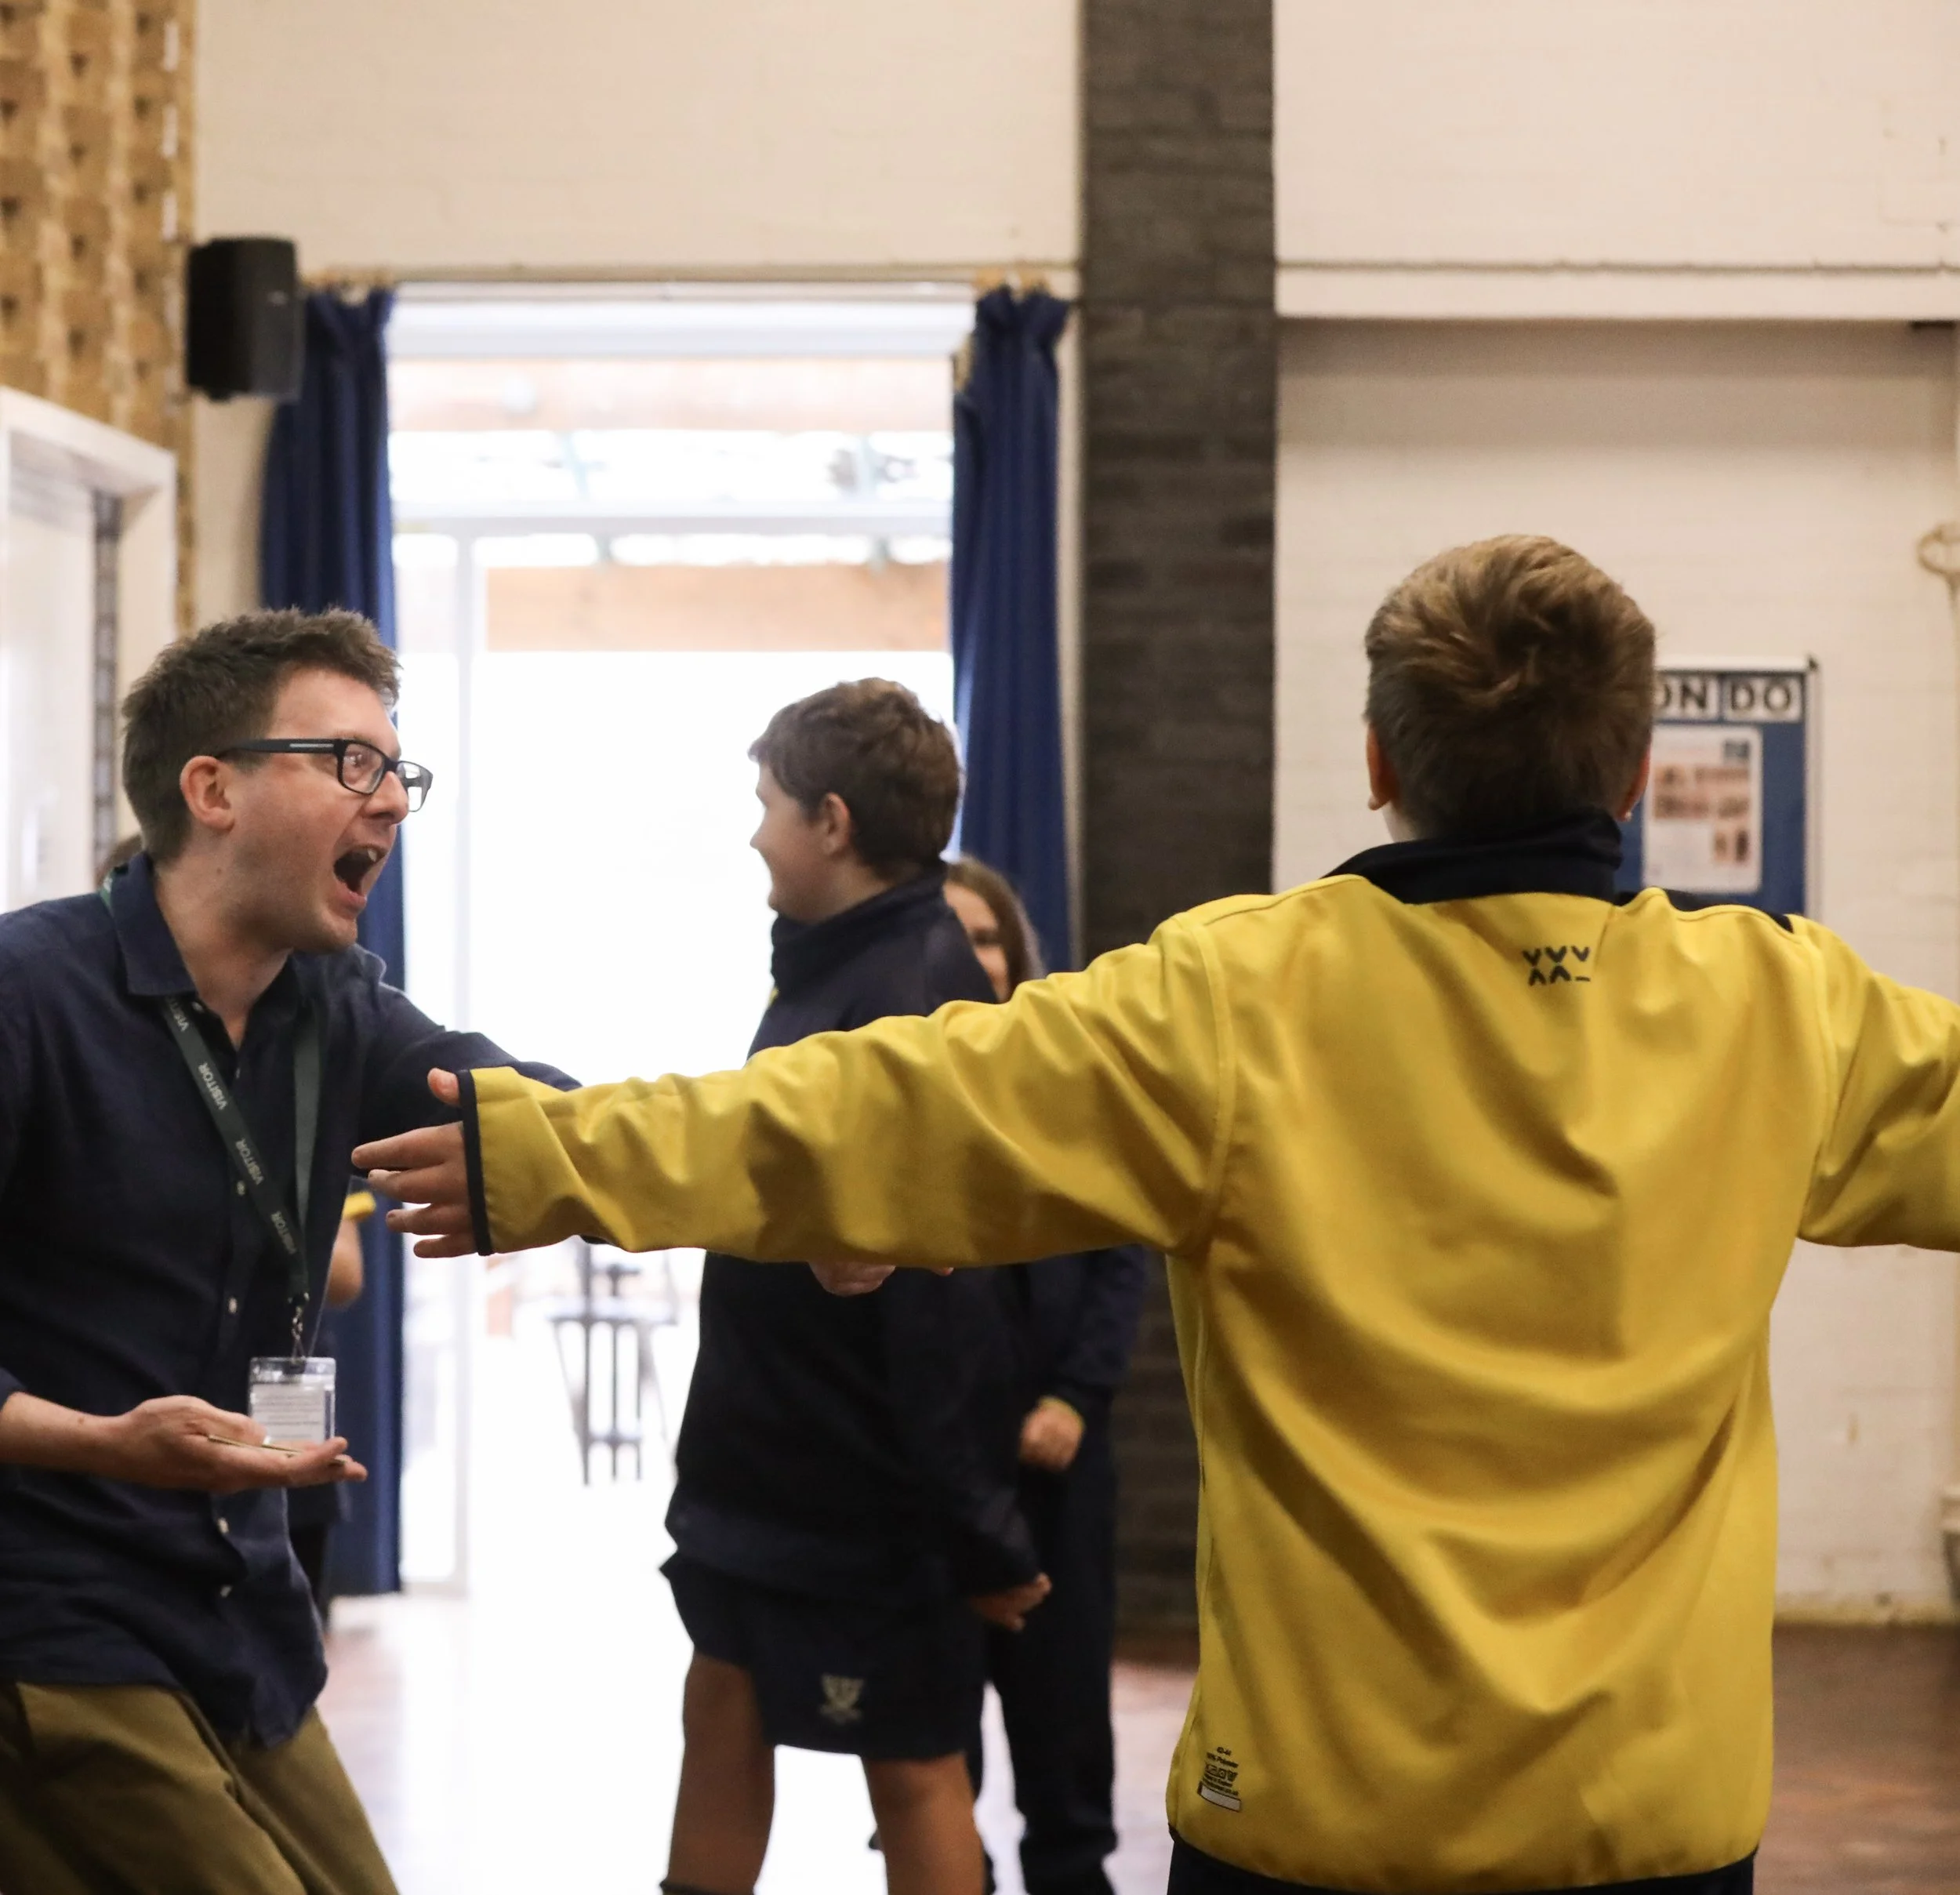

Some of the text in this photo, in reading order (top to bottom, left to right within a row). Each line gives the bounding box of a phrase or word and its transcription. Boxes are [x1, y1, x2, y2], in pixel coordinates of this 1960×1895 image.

[1730, 683, 1791, 711] DO
[198, 1062, 228, 1110] VISITOR
[235, 1138, 265, 1185] VISITOR
